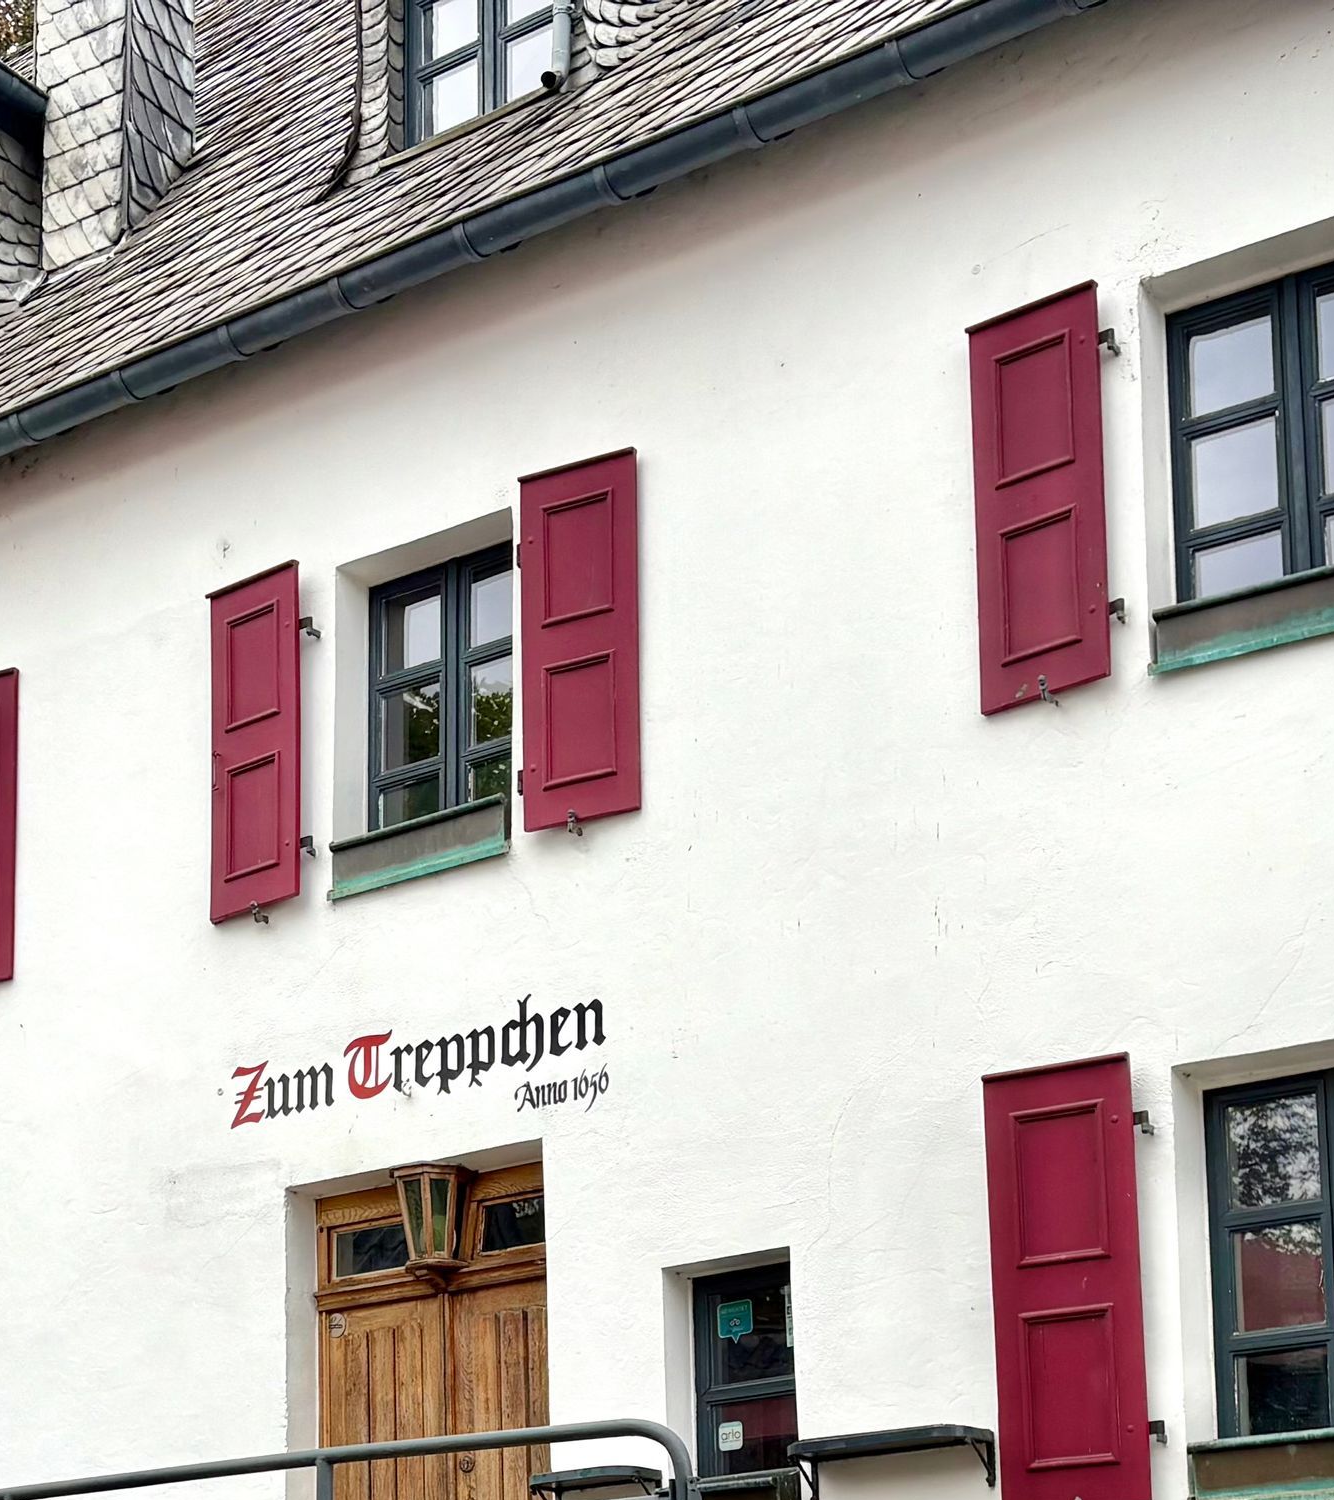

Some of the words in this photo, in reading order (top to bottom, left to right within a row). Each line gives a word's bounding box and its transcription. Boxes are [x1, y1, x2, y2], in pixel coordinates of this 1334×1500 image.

[230, 1061, 335, 1130] Zum
[343, 993, 607, 1100] Treppchen
[514, 1080, 568, 1113] Anno
[571, 1063, 610, 1113] 1656
